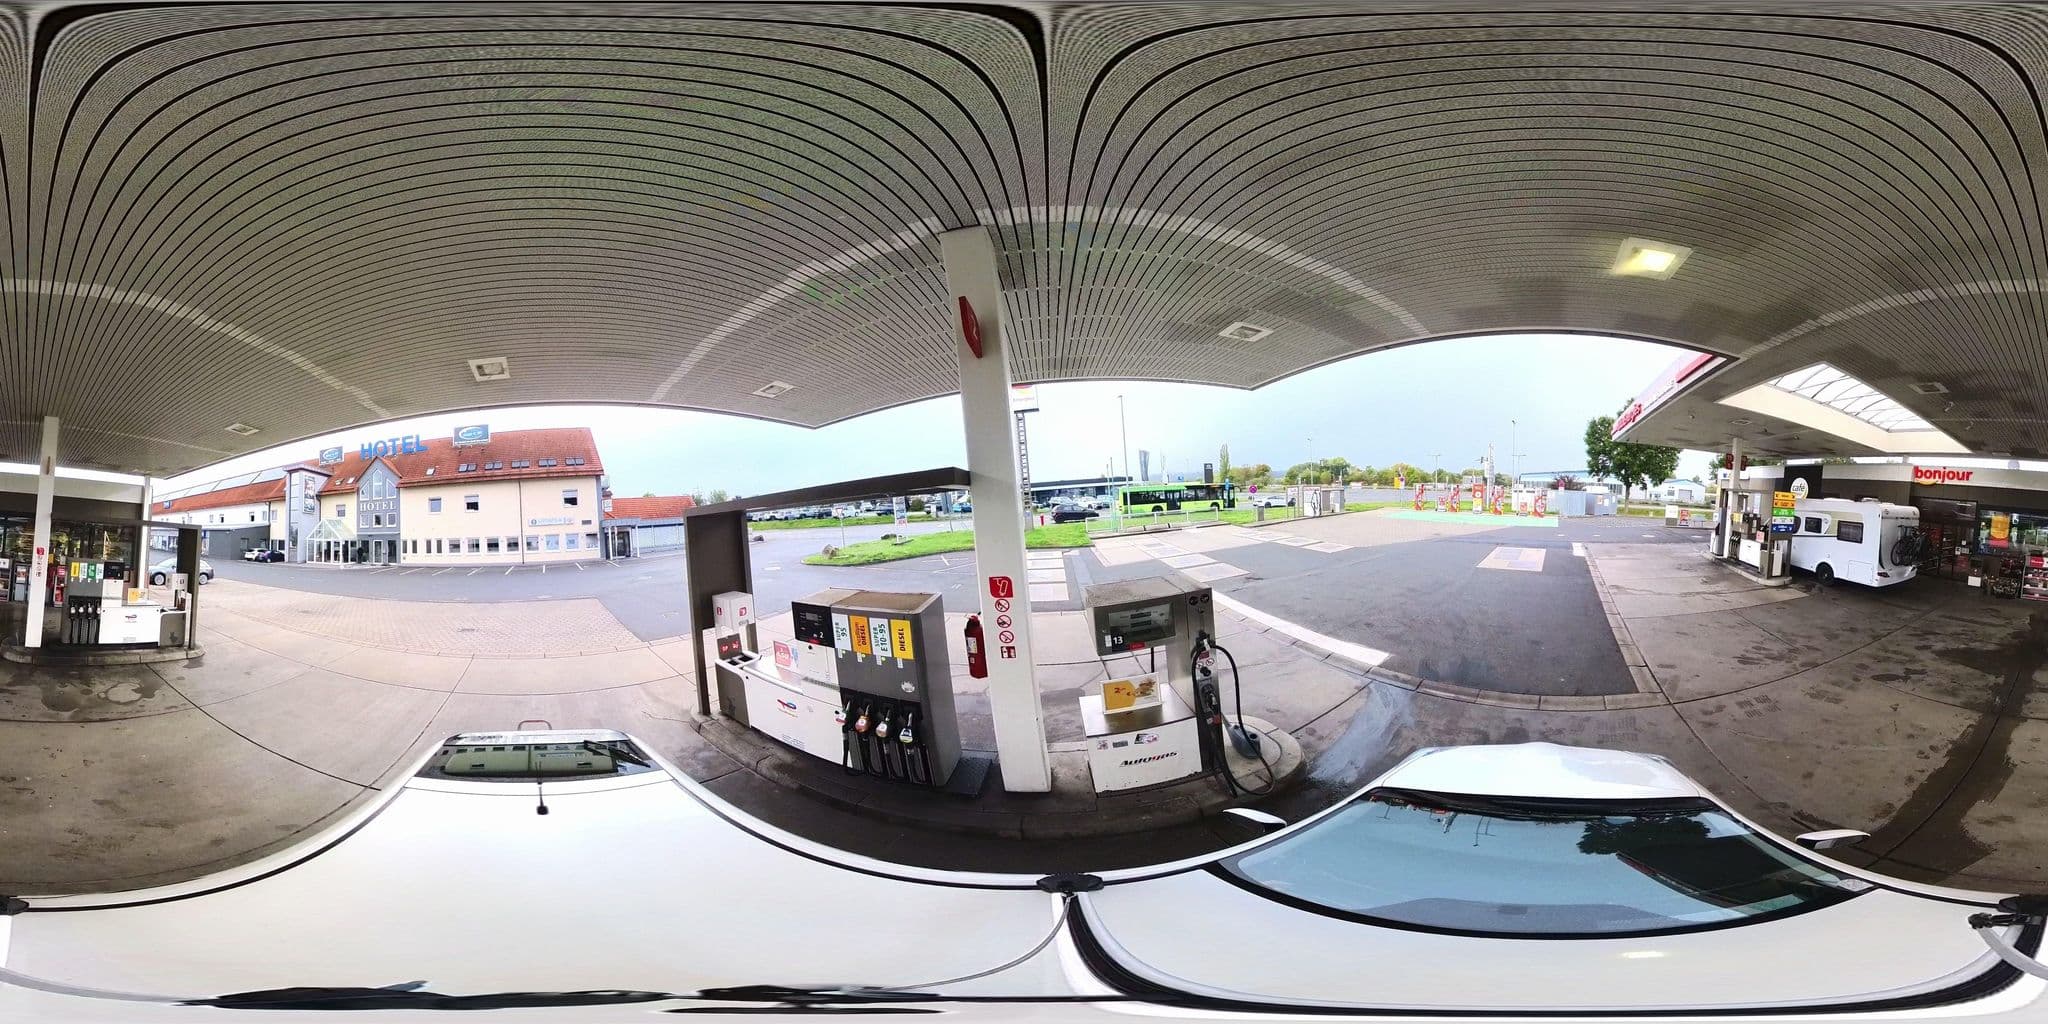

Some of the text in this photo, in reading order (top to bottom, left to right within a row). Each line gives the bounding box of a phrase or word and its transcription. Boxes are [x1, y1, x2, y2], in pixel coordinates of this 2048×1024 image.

[360, 434, 429, 460] HOTEL
[1914, 465, 1973, 483] bonjour
[360, 501, 397, 512] HOTEL
[819, 631, 825, 639] 2
[840, 627, 847, 638] 95
[879, 623, 889, 652] E10-95
[898, 627, 906, 652] DIESEL
[1113, 635, 1123, 645] 13
